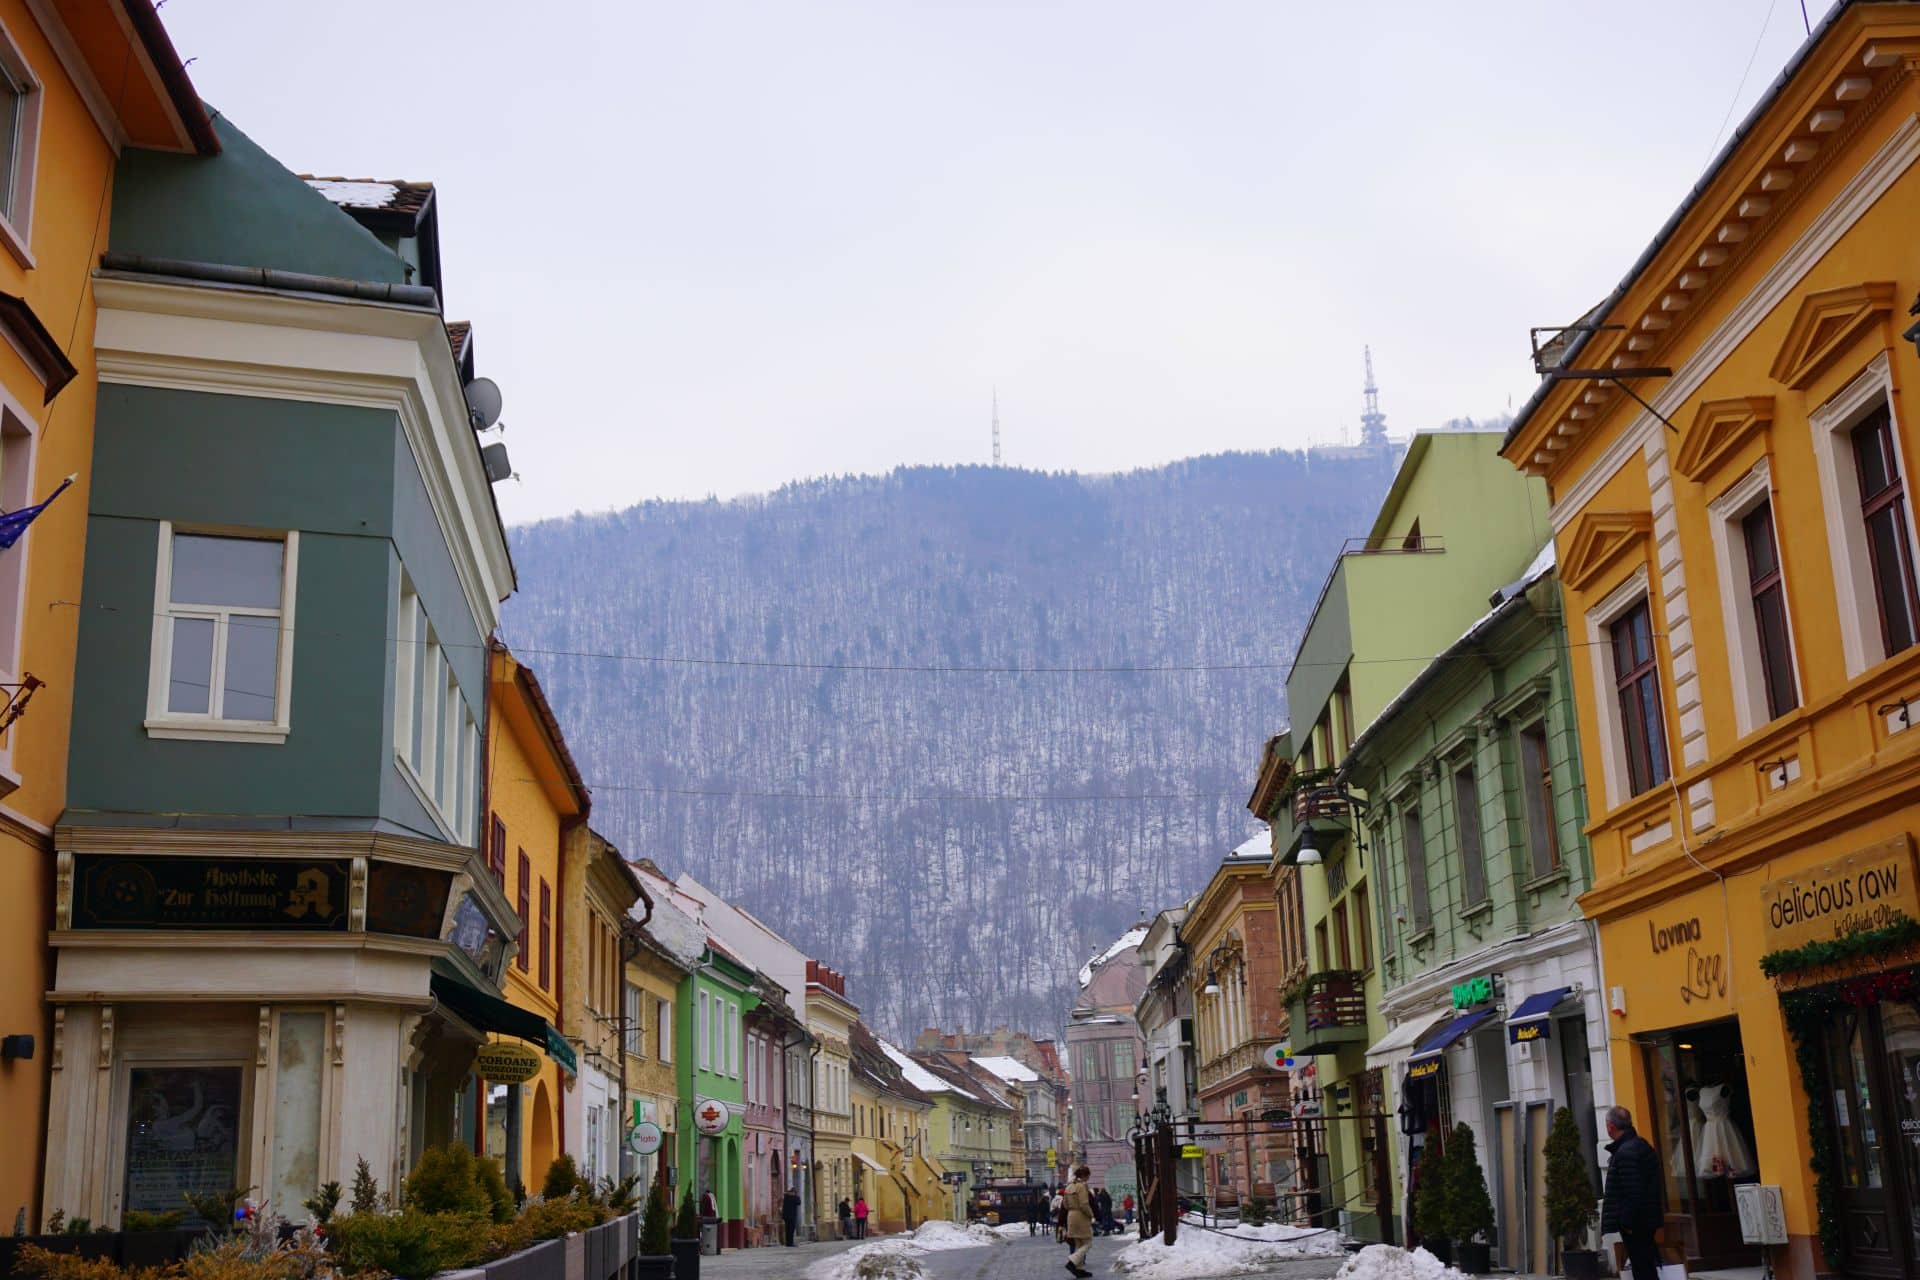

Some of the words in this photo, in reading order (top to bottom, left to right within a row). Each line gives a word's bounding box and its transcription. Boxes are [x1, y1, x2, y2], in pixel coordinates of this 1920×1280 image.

[202, 866, 278, 889] Apotheke
[1771, 878, 1853, 929] delicious
[1858, 863, 1897, 903] raw
[1649, 917, 1701, 955] Lavinia
[478, 1055, 537, 1067] COROANE
[640, 1135, 657, 1143] loto
